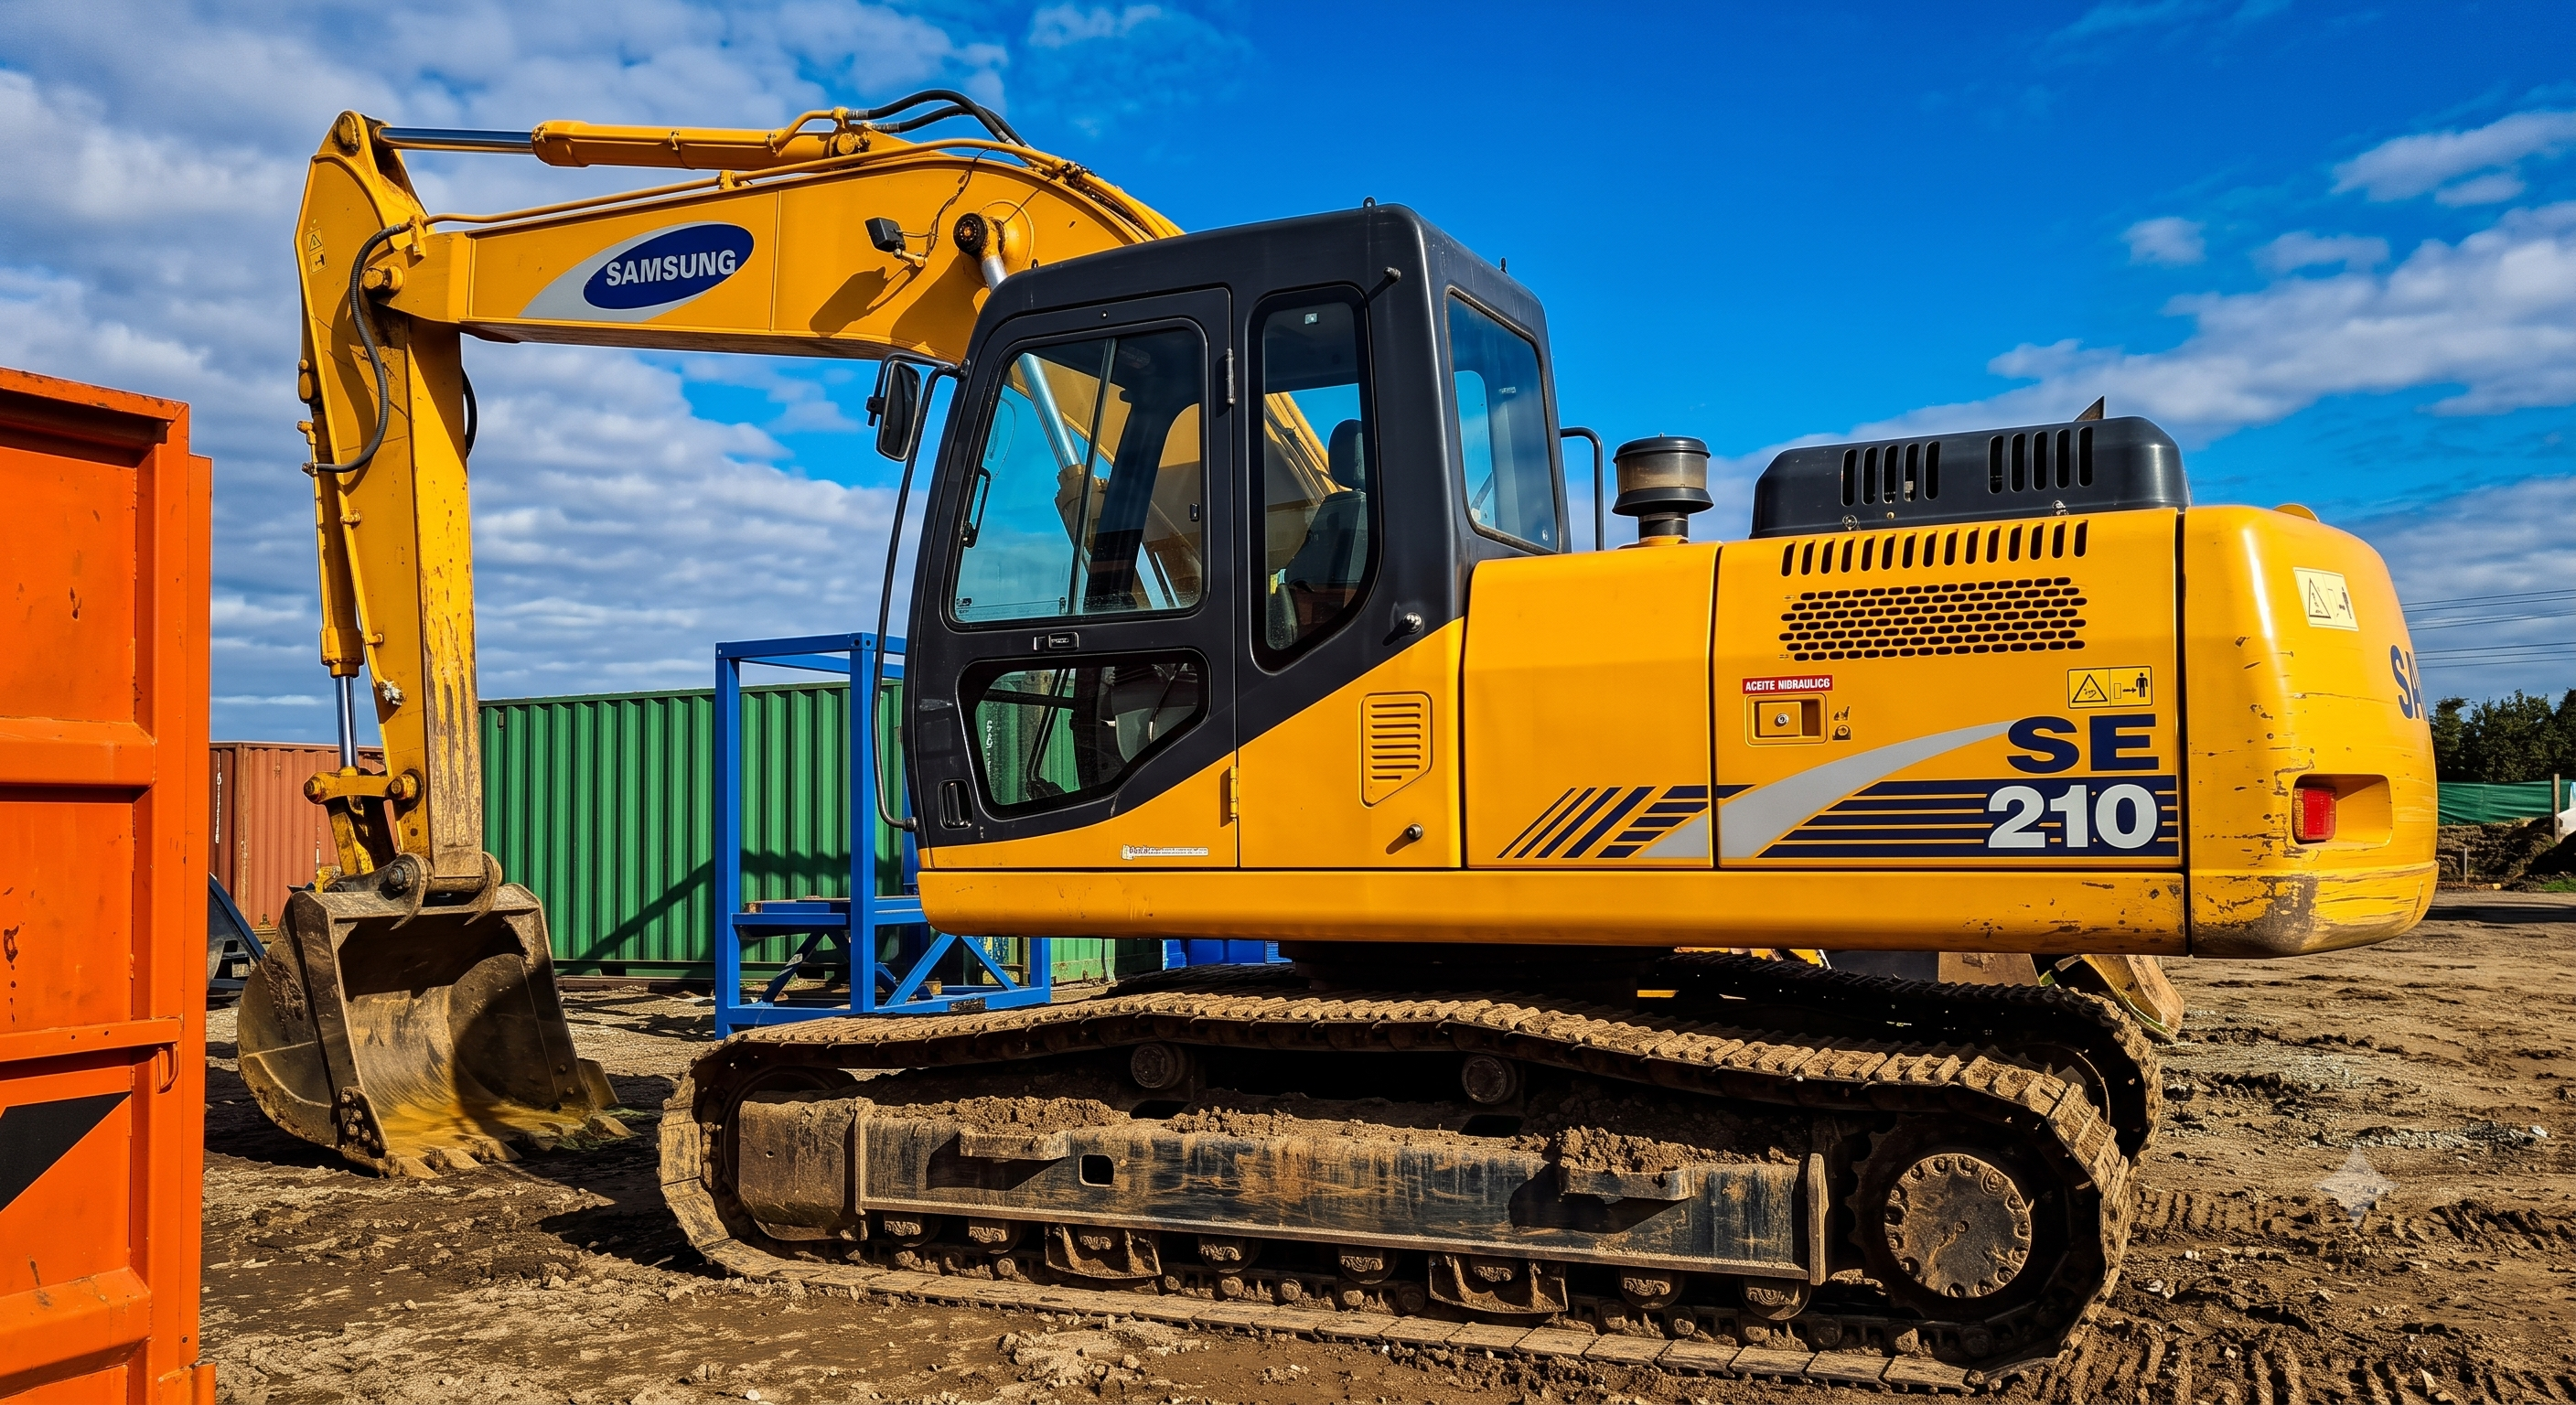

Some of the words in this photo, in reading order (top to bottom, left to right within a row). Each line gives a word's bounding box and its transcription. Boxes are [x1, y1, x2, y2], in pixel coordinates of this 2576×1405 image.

[606, 250, 735, 286] SAMSUNG
[1745, 680, 1776, 692] ACEITE
[2390, 645, 2428, 721] SA
[2006, 713, 2159, 774] SE
[1988, 784, 2158, 849] 210
